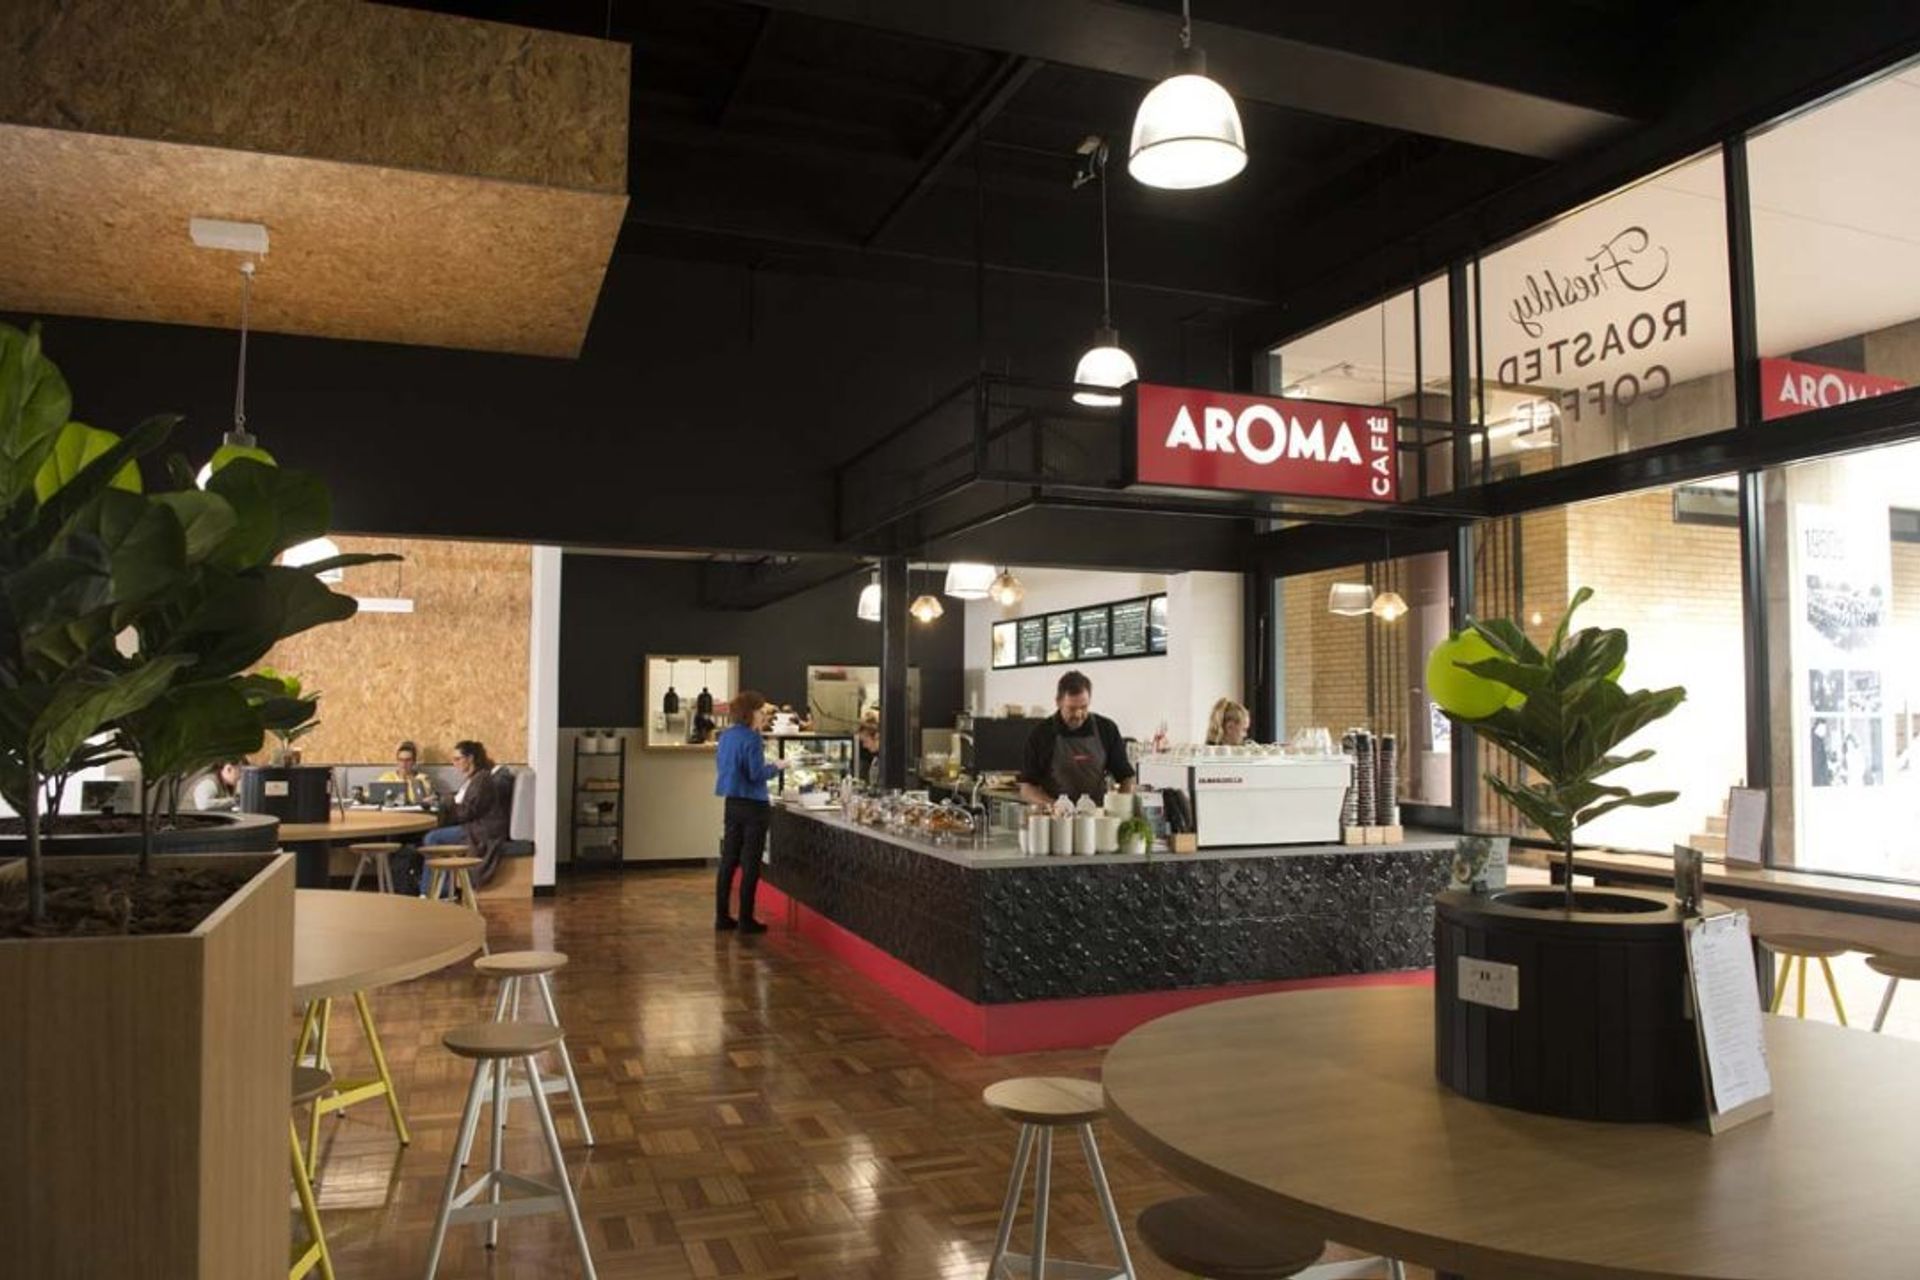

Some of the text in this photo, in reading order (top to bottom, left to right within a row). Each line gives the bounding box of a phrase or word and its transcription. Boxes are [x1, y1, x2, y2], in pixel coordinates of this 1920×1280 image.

[1779, 371, 1881, 408] AROM
[1165, 404, 1363, 464] AROMA
[1367, 416, 1390, 496] CAFÉ
